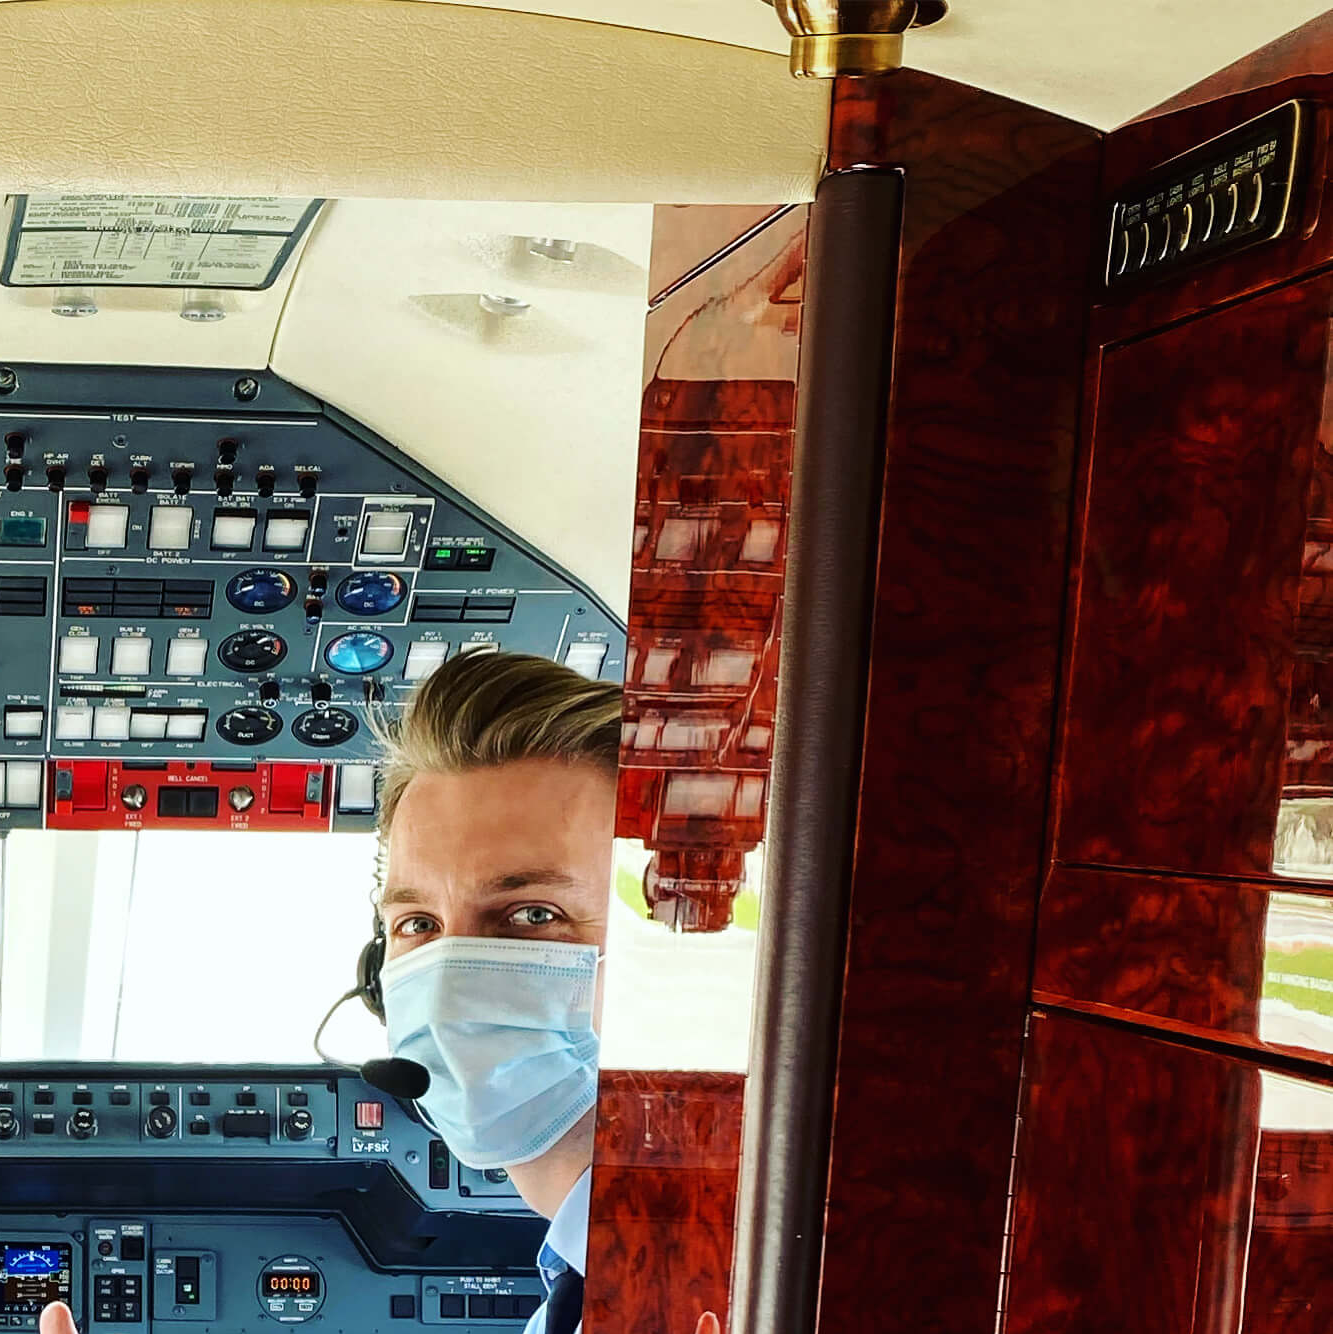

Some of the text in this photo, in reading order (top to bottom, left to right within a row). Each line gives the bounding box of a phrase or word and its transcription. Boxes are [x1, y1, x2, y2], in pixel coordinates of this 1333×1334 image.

[112, 414, 135, 422] TEST
[295, 465, 322, 473] SELCAL
[186, 775, 208, 783] CANCEL
[352, 1142, 390, 1153] LY-FSK
